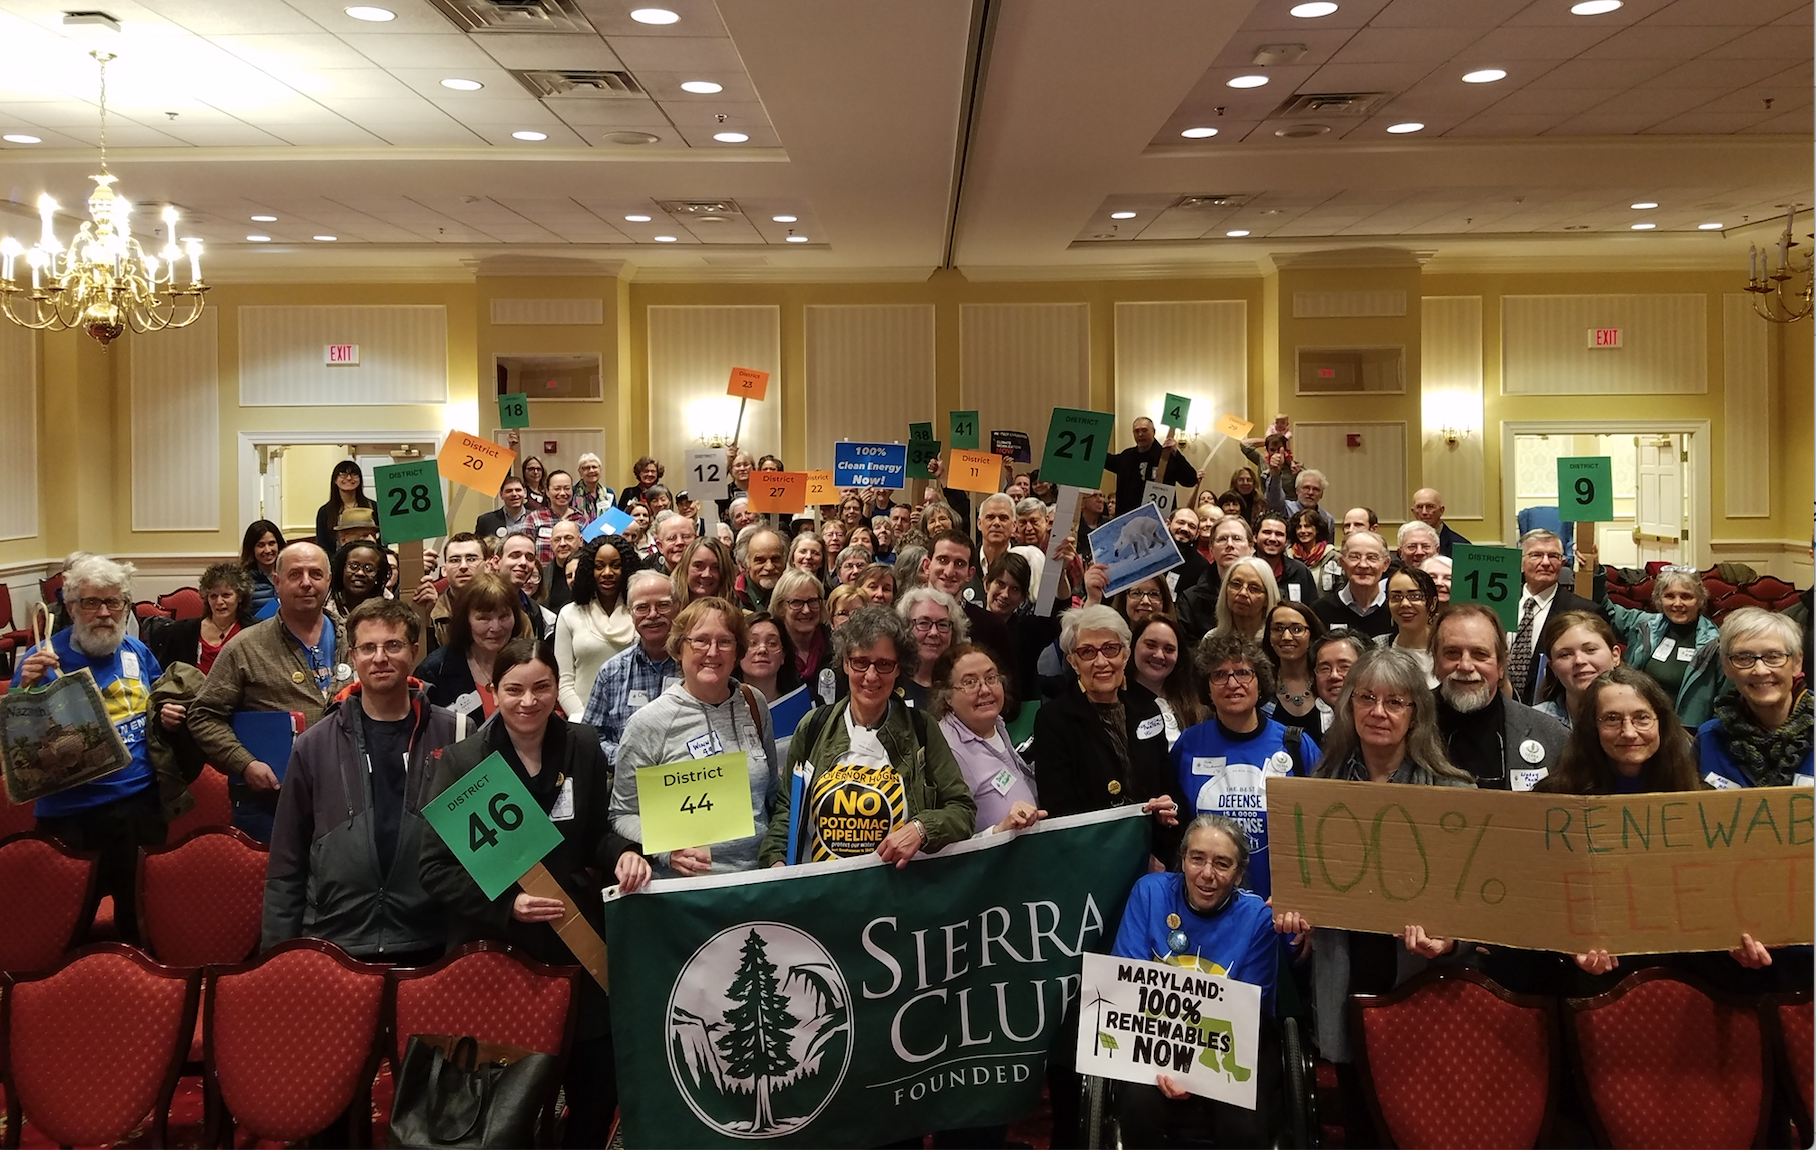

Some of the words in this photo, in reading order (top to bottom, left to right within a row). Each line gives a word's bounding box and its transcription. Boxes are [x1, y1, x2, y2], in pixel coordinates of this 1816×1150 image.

[1596, 329, 1618, 346] EXIT
[330, 345, 352, 361] EXIT
[738, 371, 761, 380] District
[742, 380, 753, 389] 23
[504, 403, 523, 417] 18
[1170, 406, 1181, 420] 4
[955, 421, 972, 436] 41
[1065, 415, 1099, 426] DISTRICT
[462, 437, 500, 459] District
[855, 446, 887, 457] 100%
[1053, 430, 1095, 462] 21
[463, 455, 484, 471] 20
[837, 461, 866, 471] Clean
[867, 461, 902, 474] Energy
[962, 455, 990, 465] District
[388, 469, 424, 480] DISTRICT
[694, 463, 720, 482] 12
[762, 475, 795, 483] District
[852, 474, 886, 486] Now!
[970, 467, 979, 477] 11
[769, 487, 786, 498] 27
[810, 484, 823, 493] 22
[1574, 477, 1595, 505] 9
[387, 484, 432, 517] 28
[1147, 493, 1168, 510] 30
[1468, 553, 1505, 563] DISTRICT
[1463, 569, 1509, 602] 15
[663, 765, 724, 787] District
[822, 771, 867, 781] OVERNOR
[447, 774, 491, 813] DISTRICT
[1218, 793, 1263, 809] DEFENSE
[680, 792, 714, 815] 44
[833, 789, 882, 816] NO
[468, 792, 524, 853] 46
[820, 816, 889, 830] POTOMAC
[823, 828, 884, 842] PIPELINE
[1292, 801, 1507, 905] 100%
[1563, 854, 1815, 937] ELECT
[861, 892, 1104, 999] SIERRA
[1117, 964, 1225, 1002] MARYLAND:
[1138, 986, 1202, 1026] 100%
[1105, 1011, 1232, 1054] RENEWABLES
[1132, 1035, 1196, 1074] NOW
[894, 1062, 1031, 1106] FOUNDED
